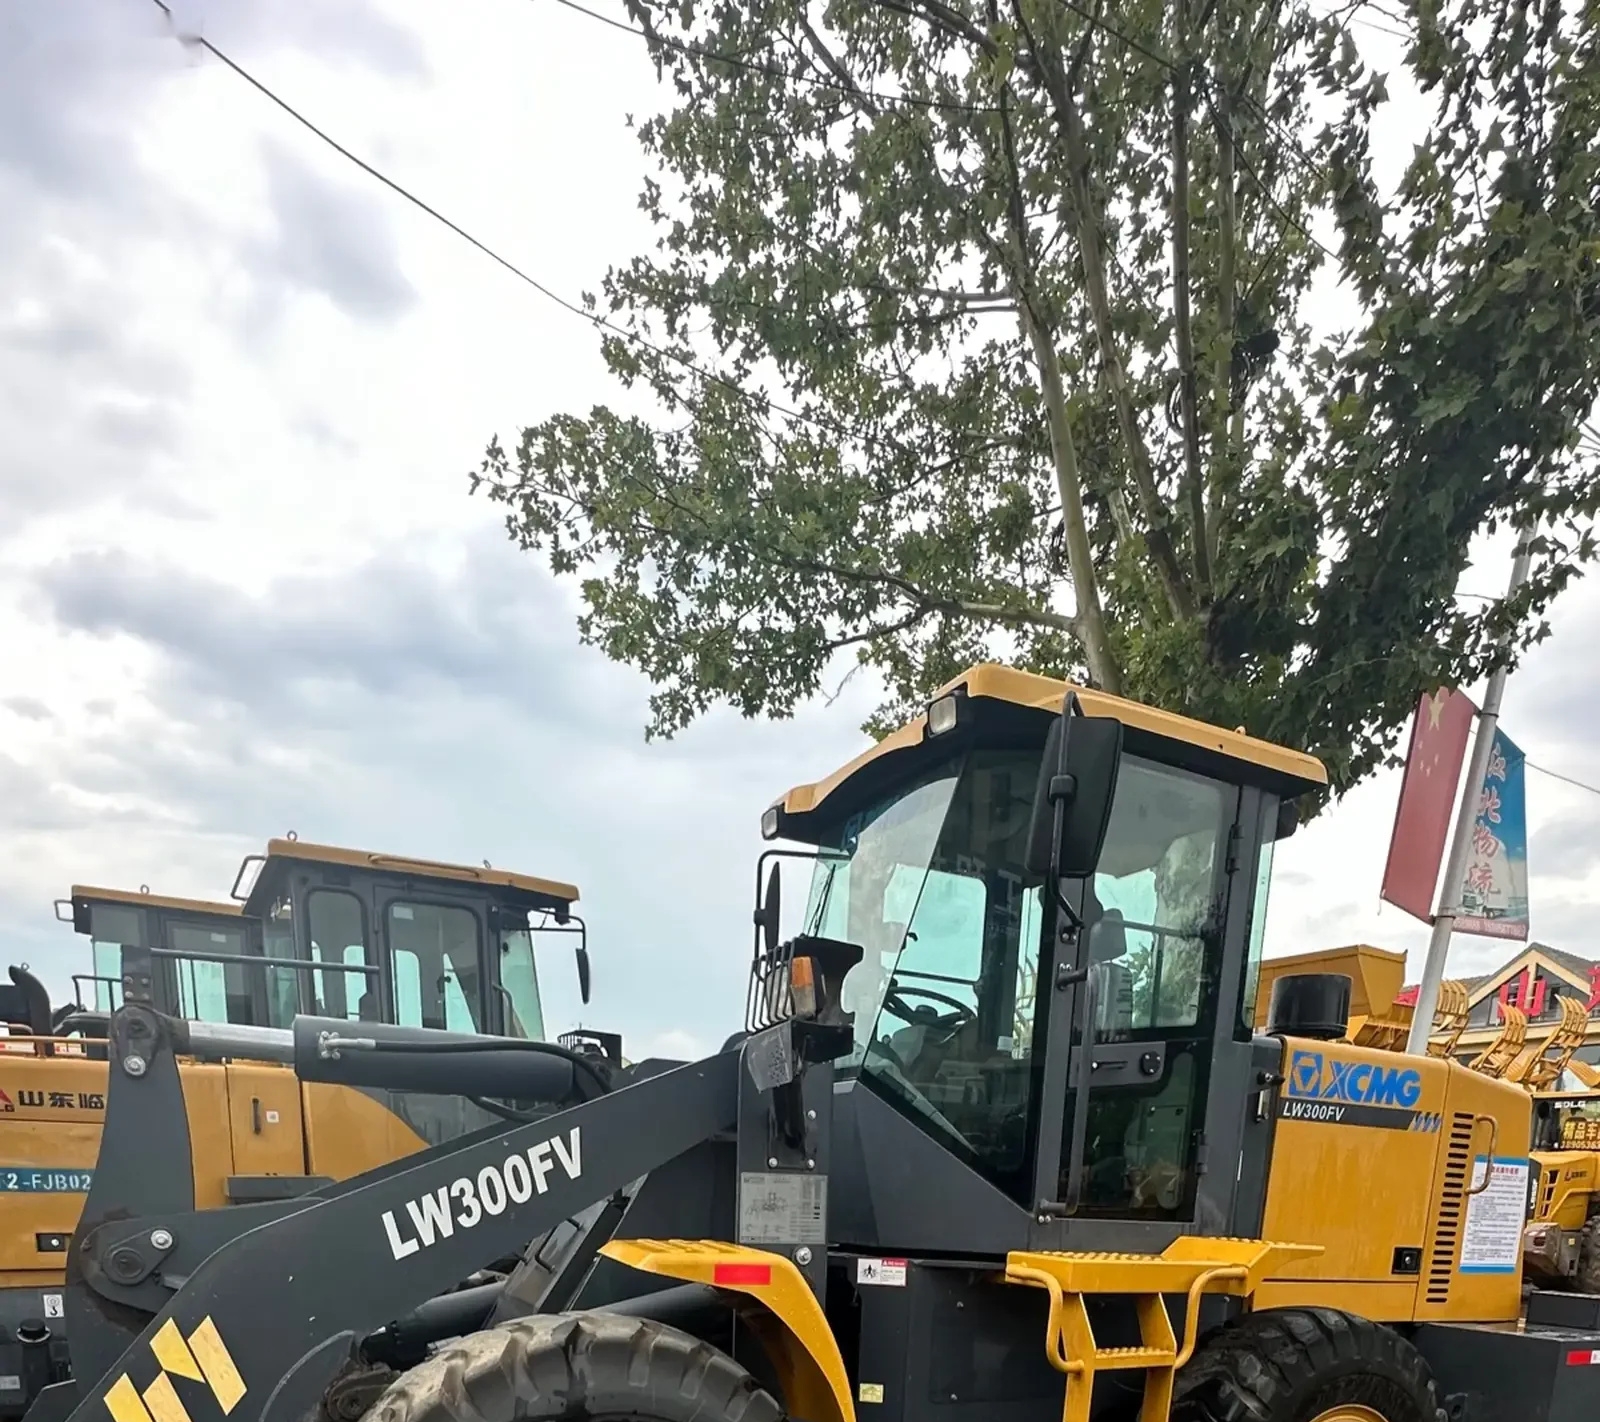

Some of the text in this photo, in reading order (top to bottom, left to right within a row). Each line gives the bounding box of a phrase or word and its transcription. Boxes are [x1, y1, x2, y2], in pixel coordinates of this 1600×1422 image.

[1320, 1060, 1422, 1108] XCMG
[1283, 1101, 1345, 1121] LW300FV
[1563, 1120, 1600, 1140] 精品车
[381, 1126, 581, 1261] LW300FV
